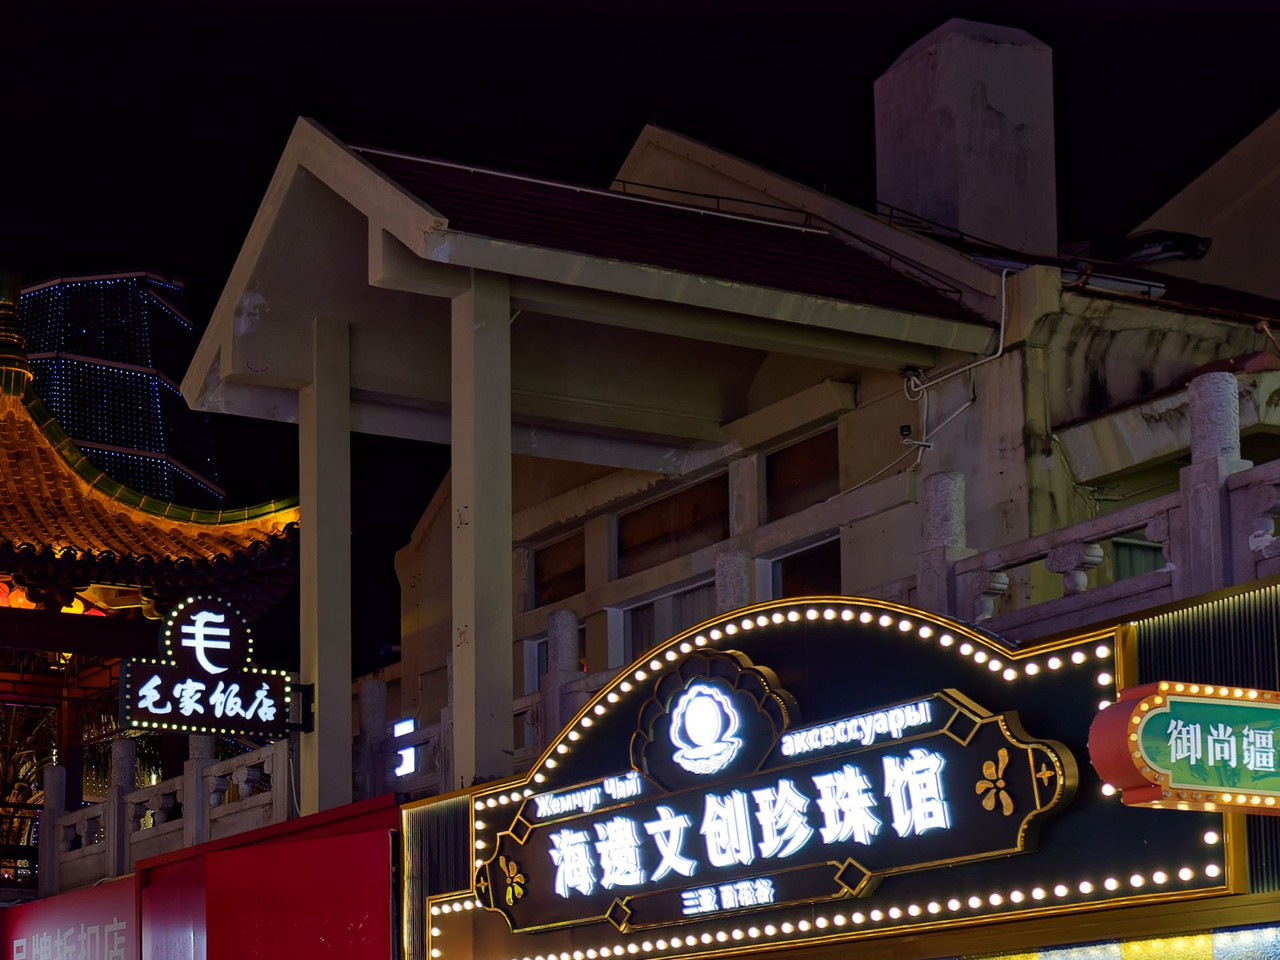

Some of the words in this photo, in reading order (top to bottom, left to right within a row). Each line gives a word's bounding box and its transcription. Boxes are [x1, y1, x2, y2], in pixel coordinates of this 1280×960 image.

[181, 610, 230, 674] 毛
[138, 674, 277, 722] 毛家饭店
[780, 701, 932, 756] аксессуары
[1167, 719, 1276, 772] 御尚疆
[534, 786, 602, 818] Жемчуг
[602, 769, 641, 800] Чай
